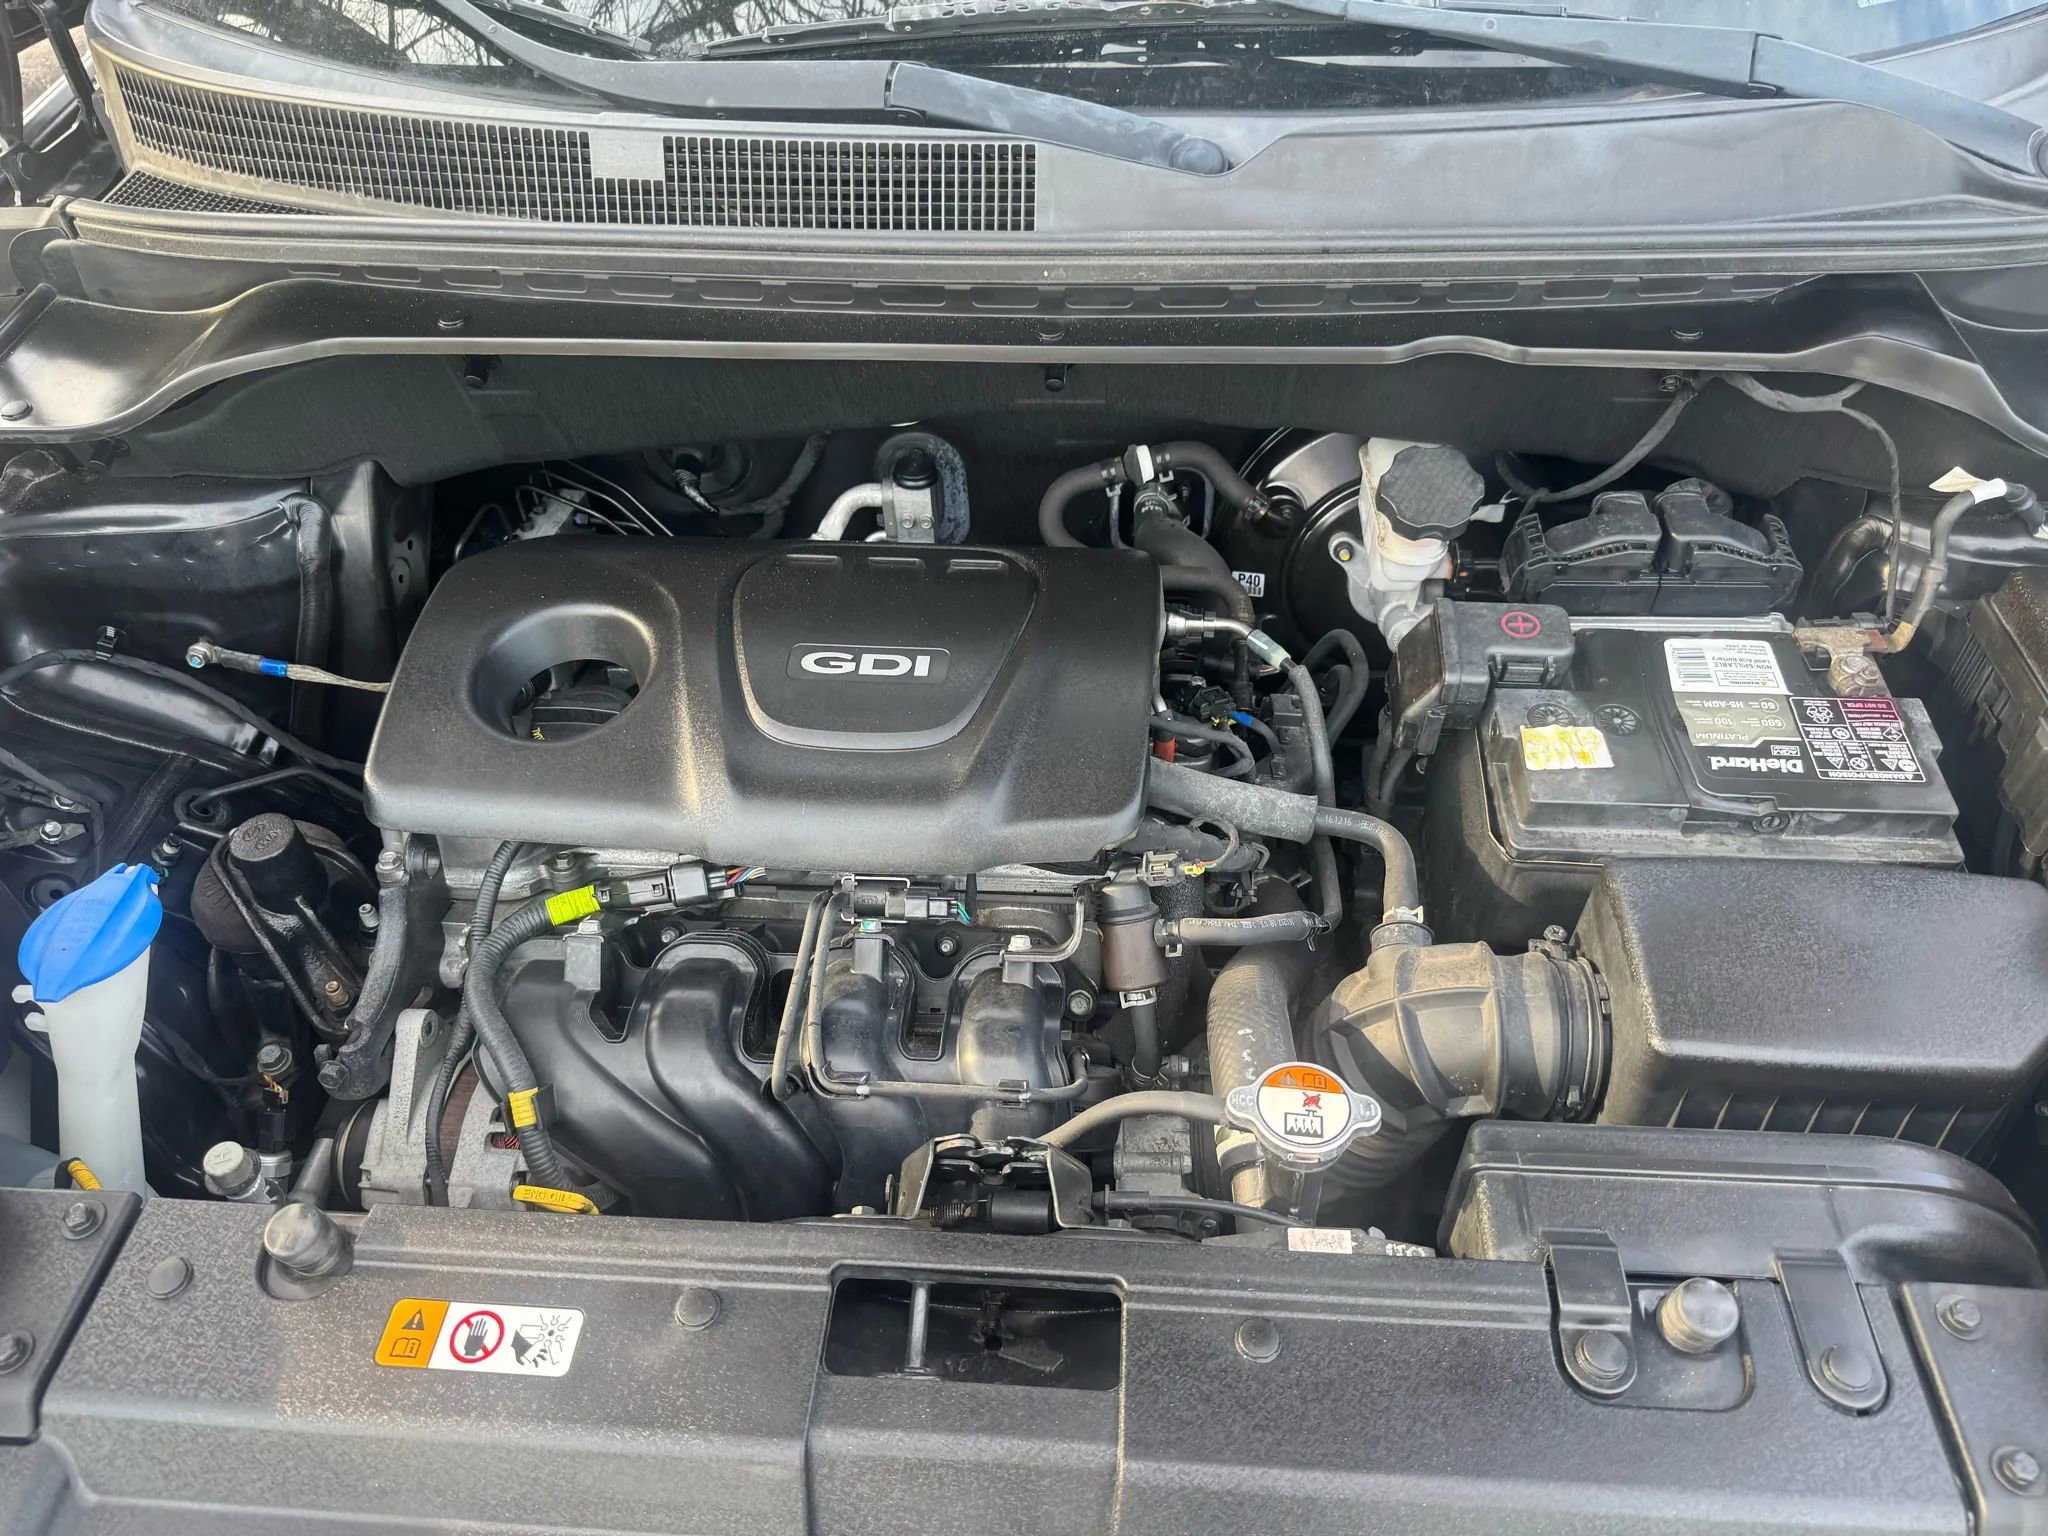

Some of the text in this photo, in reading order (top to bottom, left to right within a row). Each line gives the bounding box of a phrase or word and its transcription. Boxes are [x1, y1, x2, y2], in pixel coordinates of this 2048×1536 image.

[1238, 573, 1261, 587] P40
[800, 651, 931, 677] GDI
[1695, 732, 1750, 741] PLATINUM
[1231, 1094, 1254, 1106] HCC
